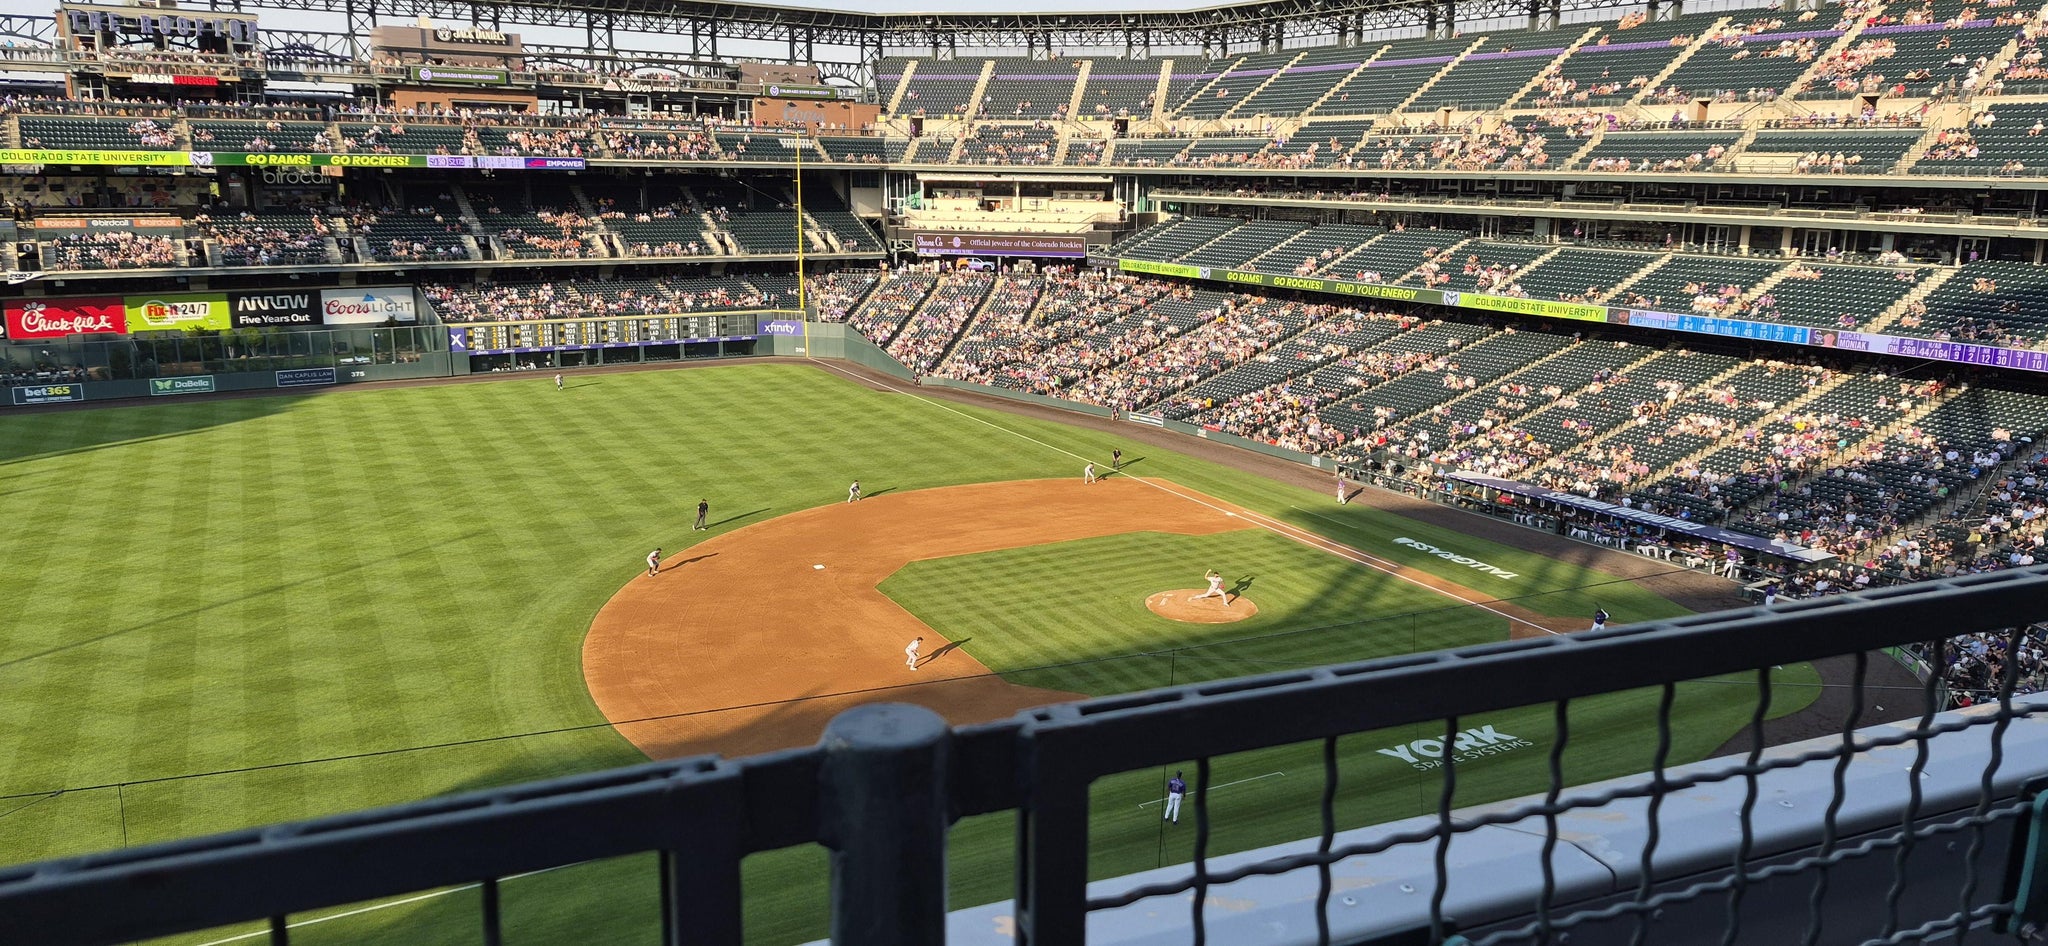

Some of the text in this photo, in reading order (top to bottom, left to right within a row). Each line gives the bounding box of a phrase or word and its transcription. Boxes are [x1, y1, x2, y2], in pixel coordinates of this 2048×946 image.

[68, 10, 258, 41] THE ROOFTOP
[620, 79, 652, 92] Silver
[1, 152, 166, 162] COLORADO STATE UNIVERSITY
[246, 154, 311, 165] GO RAMS!
[331, 156, 409, 166] GO ROCKIES!
[917, 236, 934, 246] Shane
[1162, 265, 1189, 274] UNIVERSITY
[1227, 272, 1263, 284] GO RAMS!
[1273, 276, 1324, 290] GO ROCKIES!
[1336, 283, 1417, 300] FIND YOUR ENERGY
[238, 294, 308, 311] ARROW
[325, 299, 412, 316] Coors LIGHT
[147, 304, 207, 316] Fix-it 24/7
[1476, 298, 1600, 318] COLORADO STATE UNIVERSITY
[240, 314, 310, 324] Five Years Out
[764, 322, 796, 334] xfinity
[1840, 332, 1862, 340] MICKEY
[1840, 340, 1867, 350] MONIAK
[1888, 345, 1898, 353] DH
[1920, 348, 1948, 358] 44/164
[1982, 355, 1989, 364] 12
[1996, 357, 2007, 365] 30
[2032, 360, 2042, 369] 10
[175, 380, 208, 388] DaBella
[24, 386, 70, 396] bet365
[1403, 541, 1520, 580] TALLGRASS
[1375, 724, 1518, 764] YORK
[1413, 738, 1533, 771] SPAE SYSTEMS
